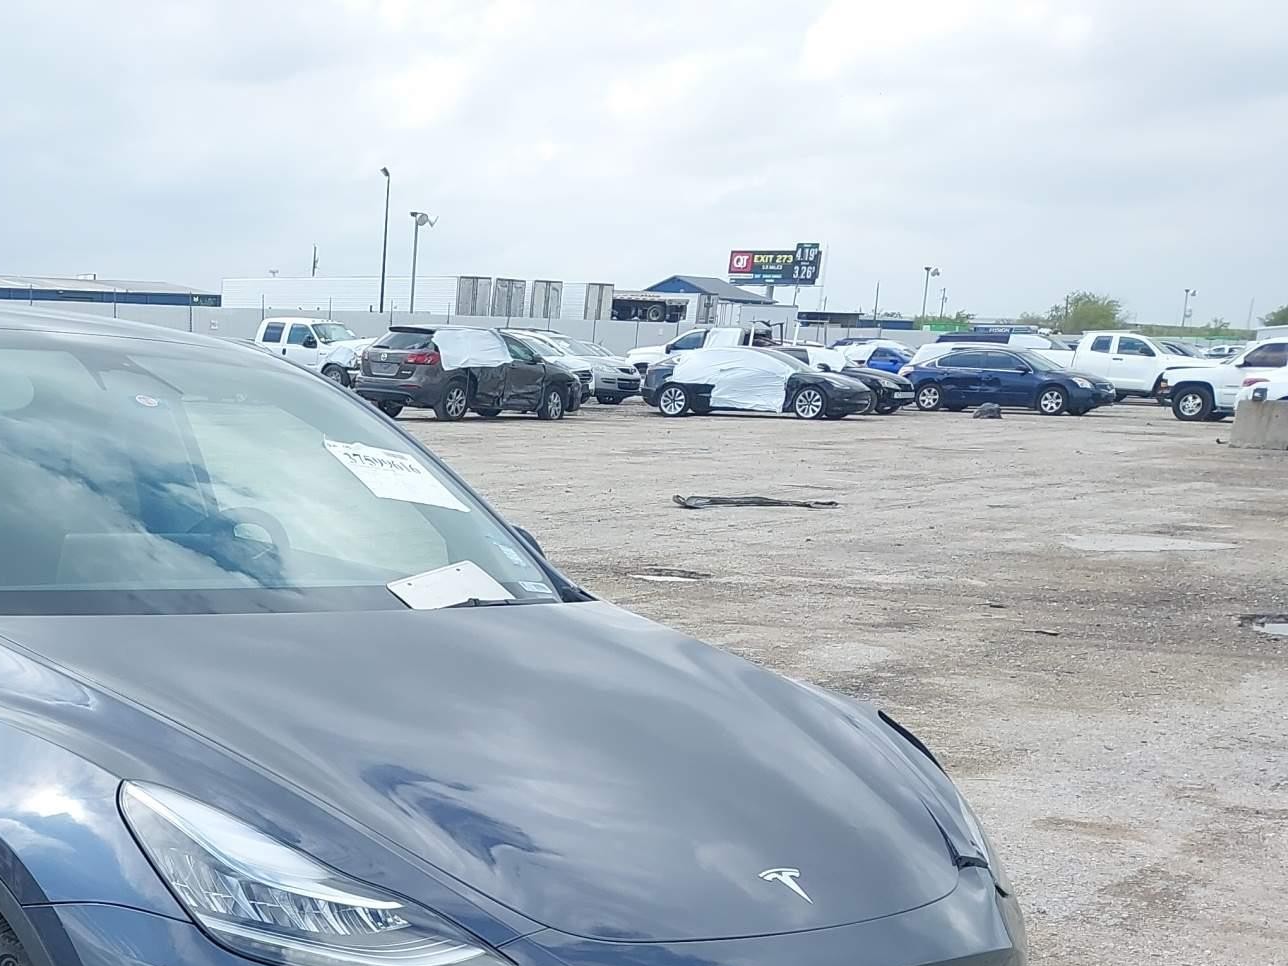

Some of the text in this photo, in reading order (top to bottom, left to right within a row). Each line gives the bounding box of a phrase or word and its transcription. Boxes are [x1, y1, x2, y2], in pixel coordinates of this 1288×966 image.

[734, 255, 749, 269] QT
[754, 255, 773, 263] EXIT
[776, 255, 793, 263] 273
